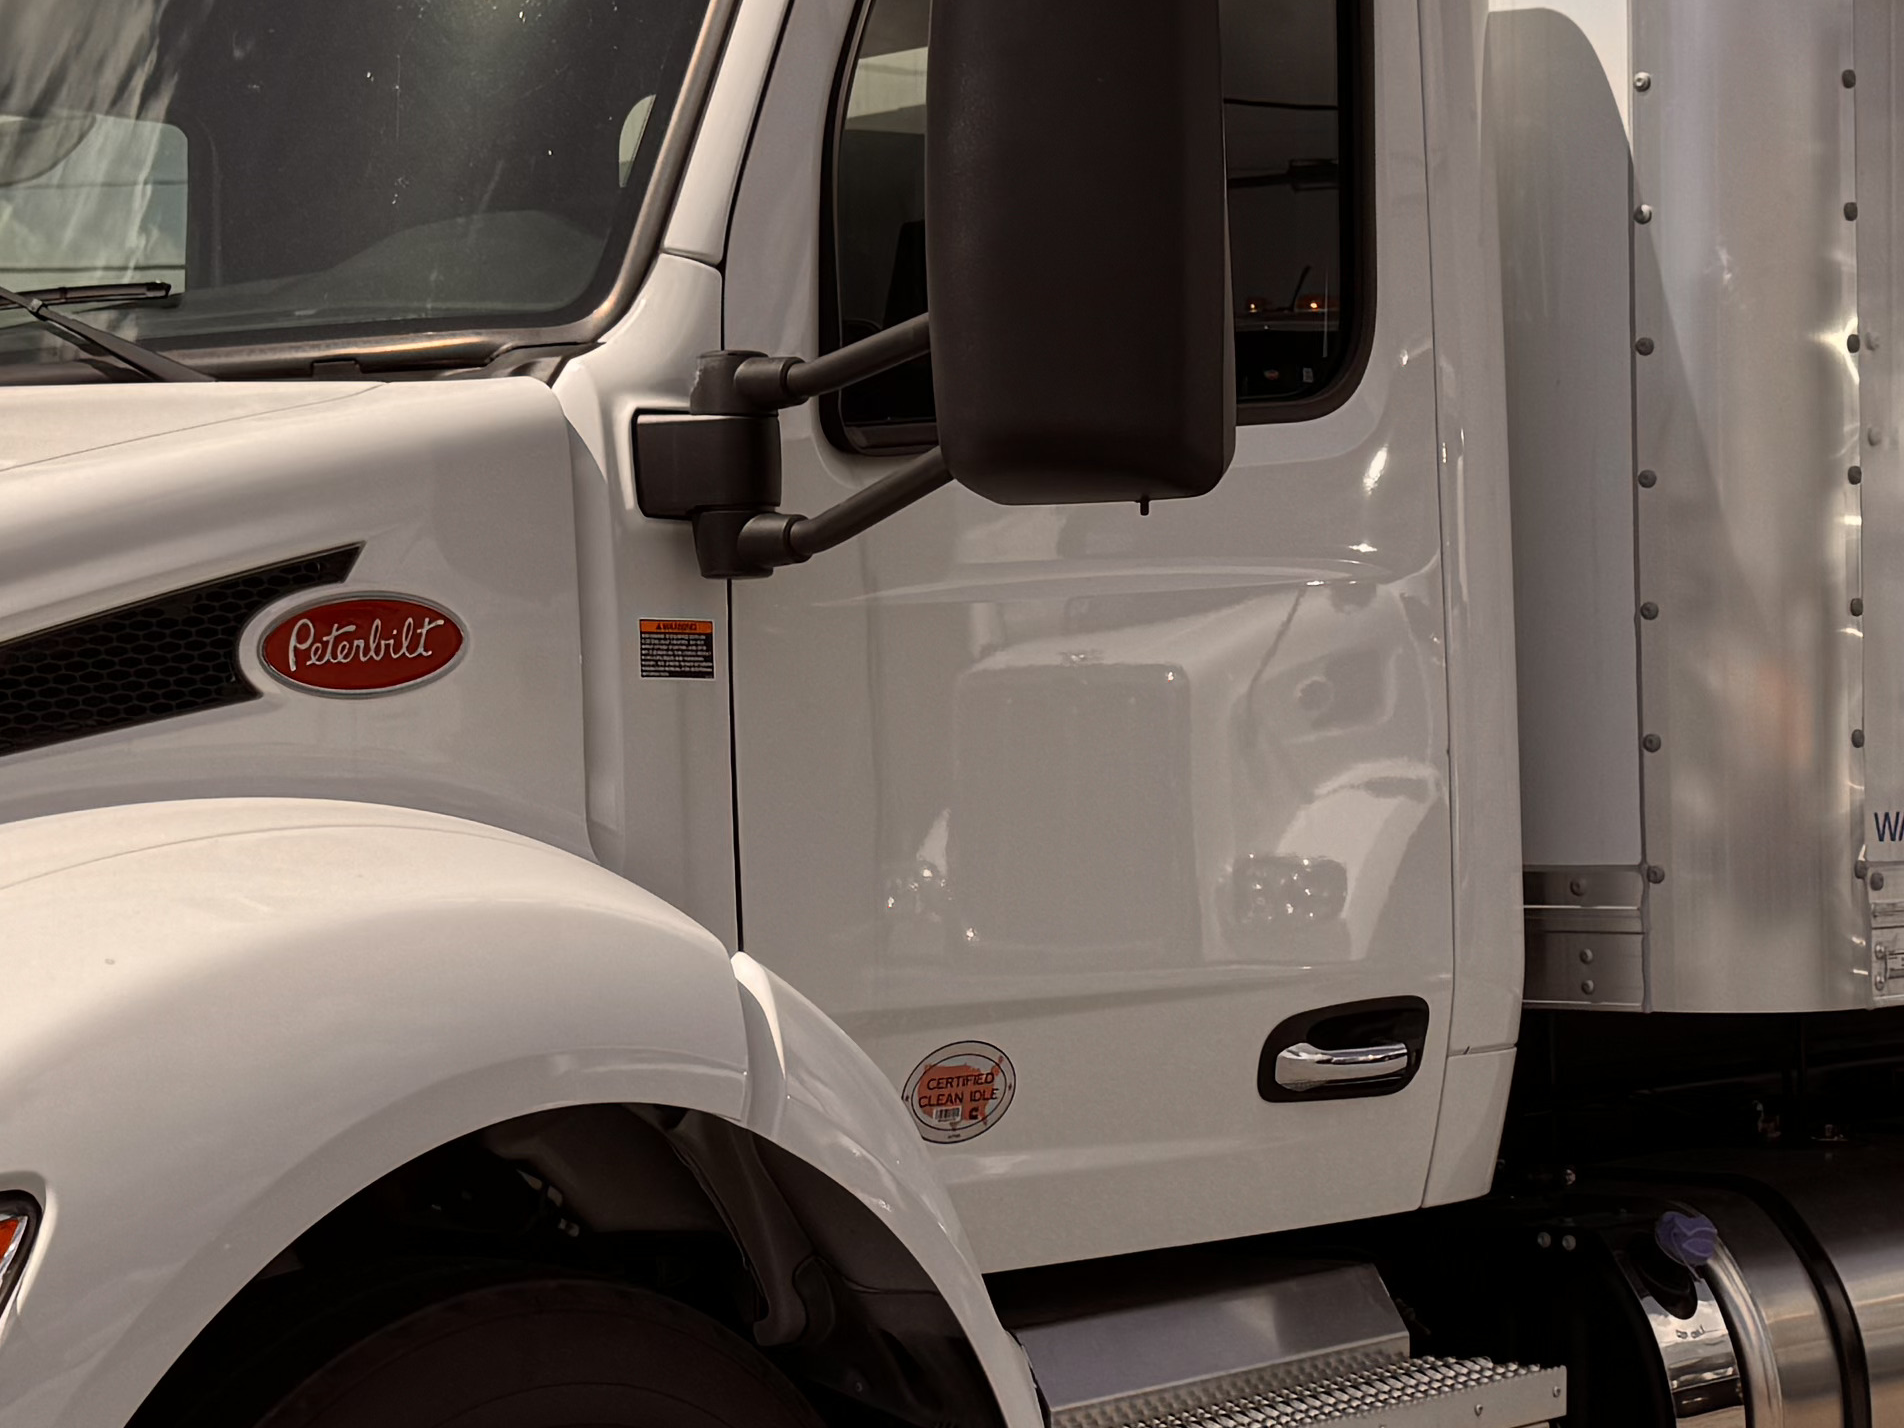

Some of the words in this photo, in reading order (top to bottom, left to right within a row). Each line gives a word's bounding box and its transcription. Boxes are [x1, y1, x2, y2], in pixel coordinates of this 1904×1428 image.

[288, 617, 445, 673] Peterbilt
[926, 1072, 995, 1090] CERTIFIED
[918, 1092, 964, 1109] CLEAN
[969, 1088, 1000, 1103] IDLE
